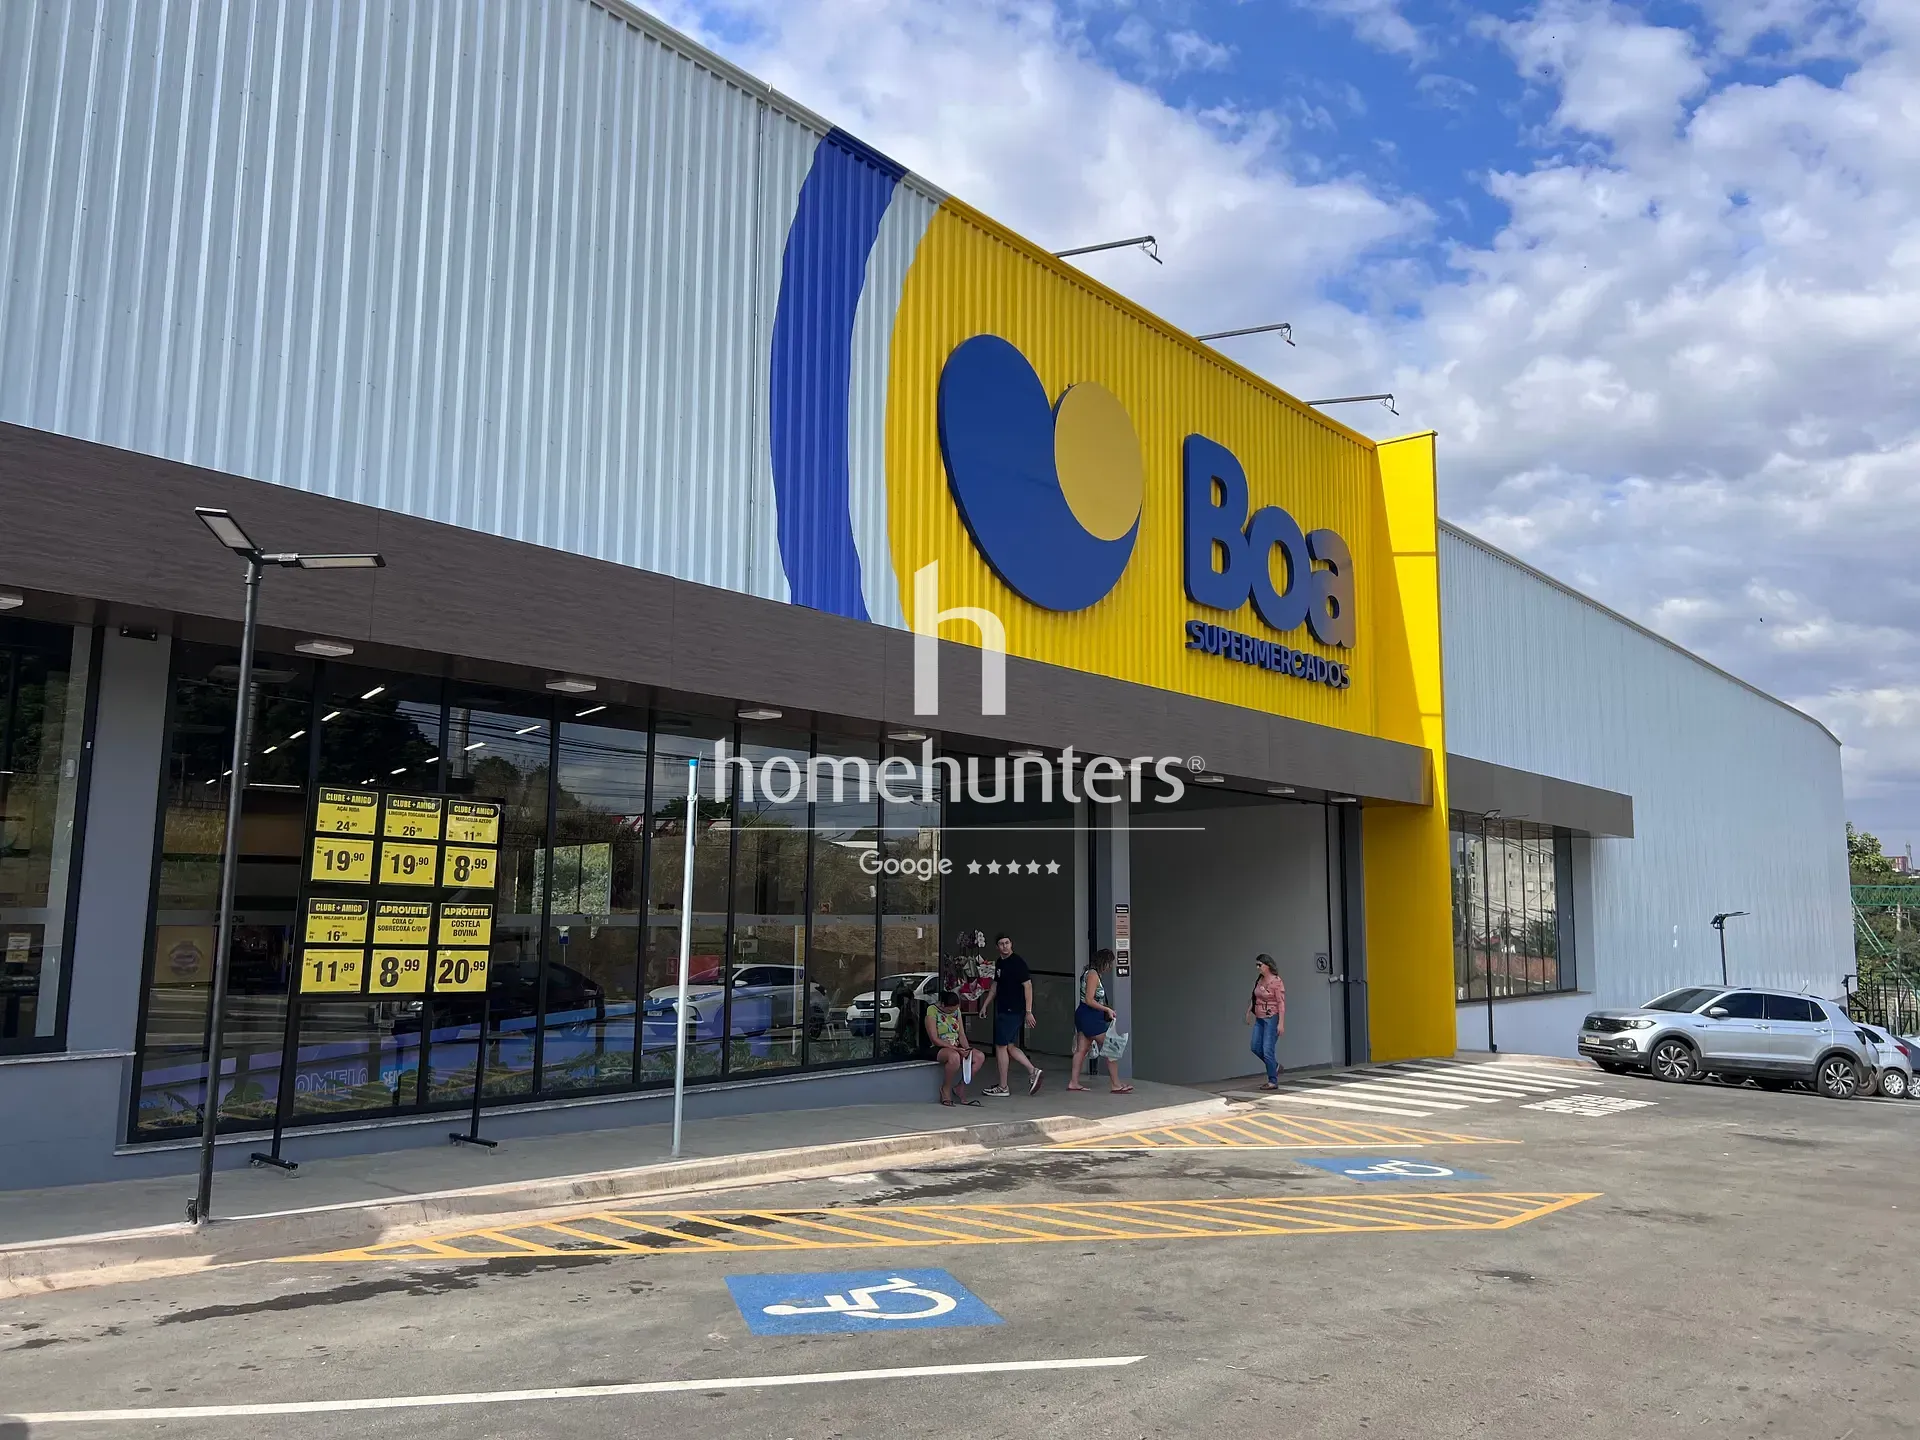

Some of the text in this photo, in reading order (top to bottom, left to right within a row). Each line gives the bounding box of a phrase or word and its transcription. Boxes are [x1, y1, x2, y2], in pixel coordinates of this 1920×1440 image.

[1183, 432, 1356, 650] Boa
[1185, 619, 1351, 690] SUPERMERCADOS
[326, 793, 346, 802] CLUBE
[351, 796, 372, 804] AMIGO
[393, 799, 411, 808] CLUBE
[416, 802, 436, 810] AMIGO
[454, 805, 472, 814] CLUBE
[476, 807, 495, 816] AMIGO
[324, 849, 365, 872] 19,90
[391, 854, 429, 875] 19,90
[454, 855, 488, 882] 8,99
[315, 903, 336, 912] CLUBE
[341, 904, 363, 912] AMIGO
[379, 905, 428, 915] APROVEITE
[444, 906, 489, 916] APROVEITE
[451, 920, 481, 928] COSTELA
[453, 929, 478, 937] BOVINA
[313, 961, 355, 982] 11,99
[380, 957, 420, 988] 8,99
[438, 959, 486, 984] 20,99
